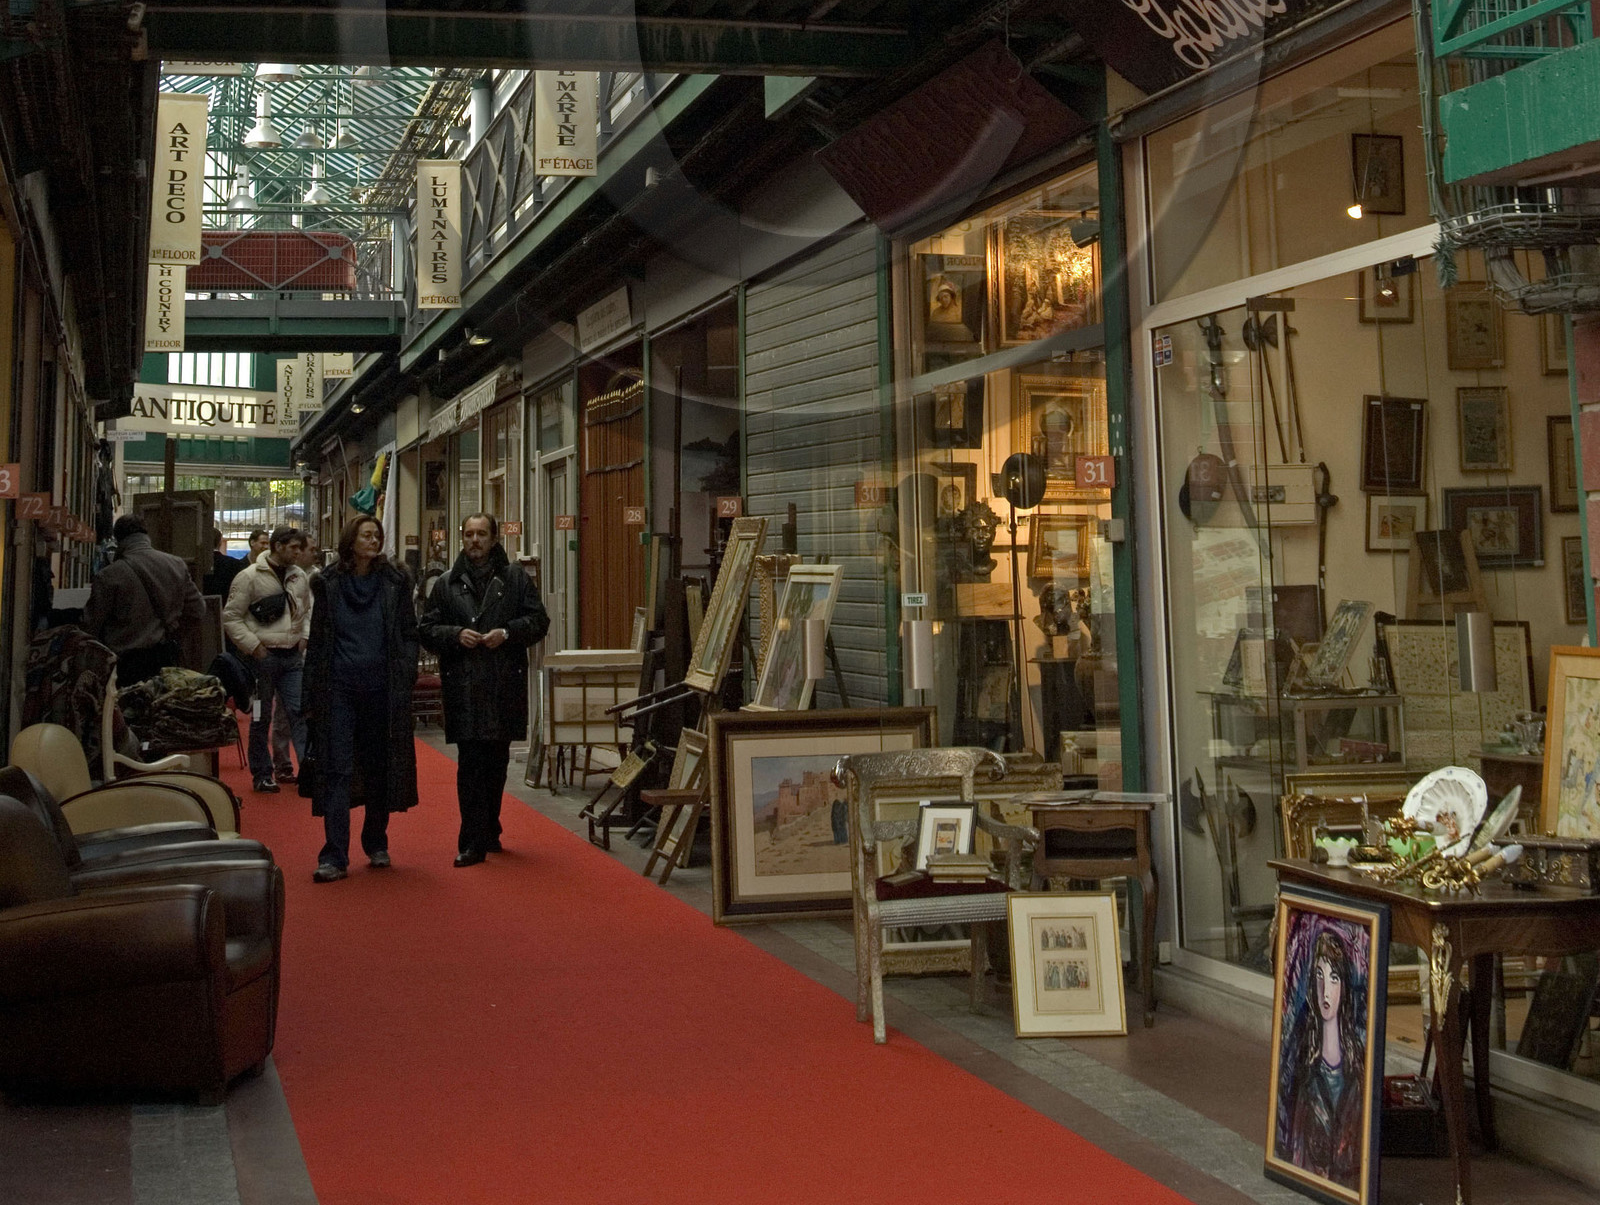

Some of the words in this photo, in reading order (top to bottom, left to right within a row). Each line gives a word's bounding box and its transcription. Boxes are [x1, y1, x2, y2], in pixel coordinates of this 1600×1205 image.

[556, 80, 579, 146] MARINE
[168, 122, 191, 163] ART
[539, 158, 552, 169] 1er
[553, 156, 594, 170] ÉTAGE
[165, 169, 189, 224] DECO
[430, 176, 449, 284] LUMINAIRES
[151, 249, 162, 259] 1st
[162, 250, 196, 260] FLOOR
[158, 280, 172, 333] COUNTRY
[430, 295, 459, 304] ÉTAGE
[155, 340, 181, 348] FLOOR
[131, 395, 278, 427] ANTIQUITÉ
[1084, 461, 1108, 483] 31
[860, 485, 880, 502] 30
[22, 497, 44, 515] 72
[722, 500, 737, 515] 29
[559, 517, 571, 528] 27
[627, 510, 642, 522] 28
[507, 524, 518, 533] 26
[907, 596, 923, 605] TIREZ
